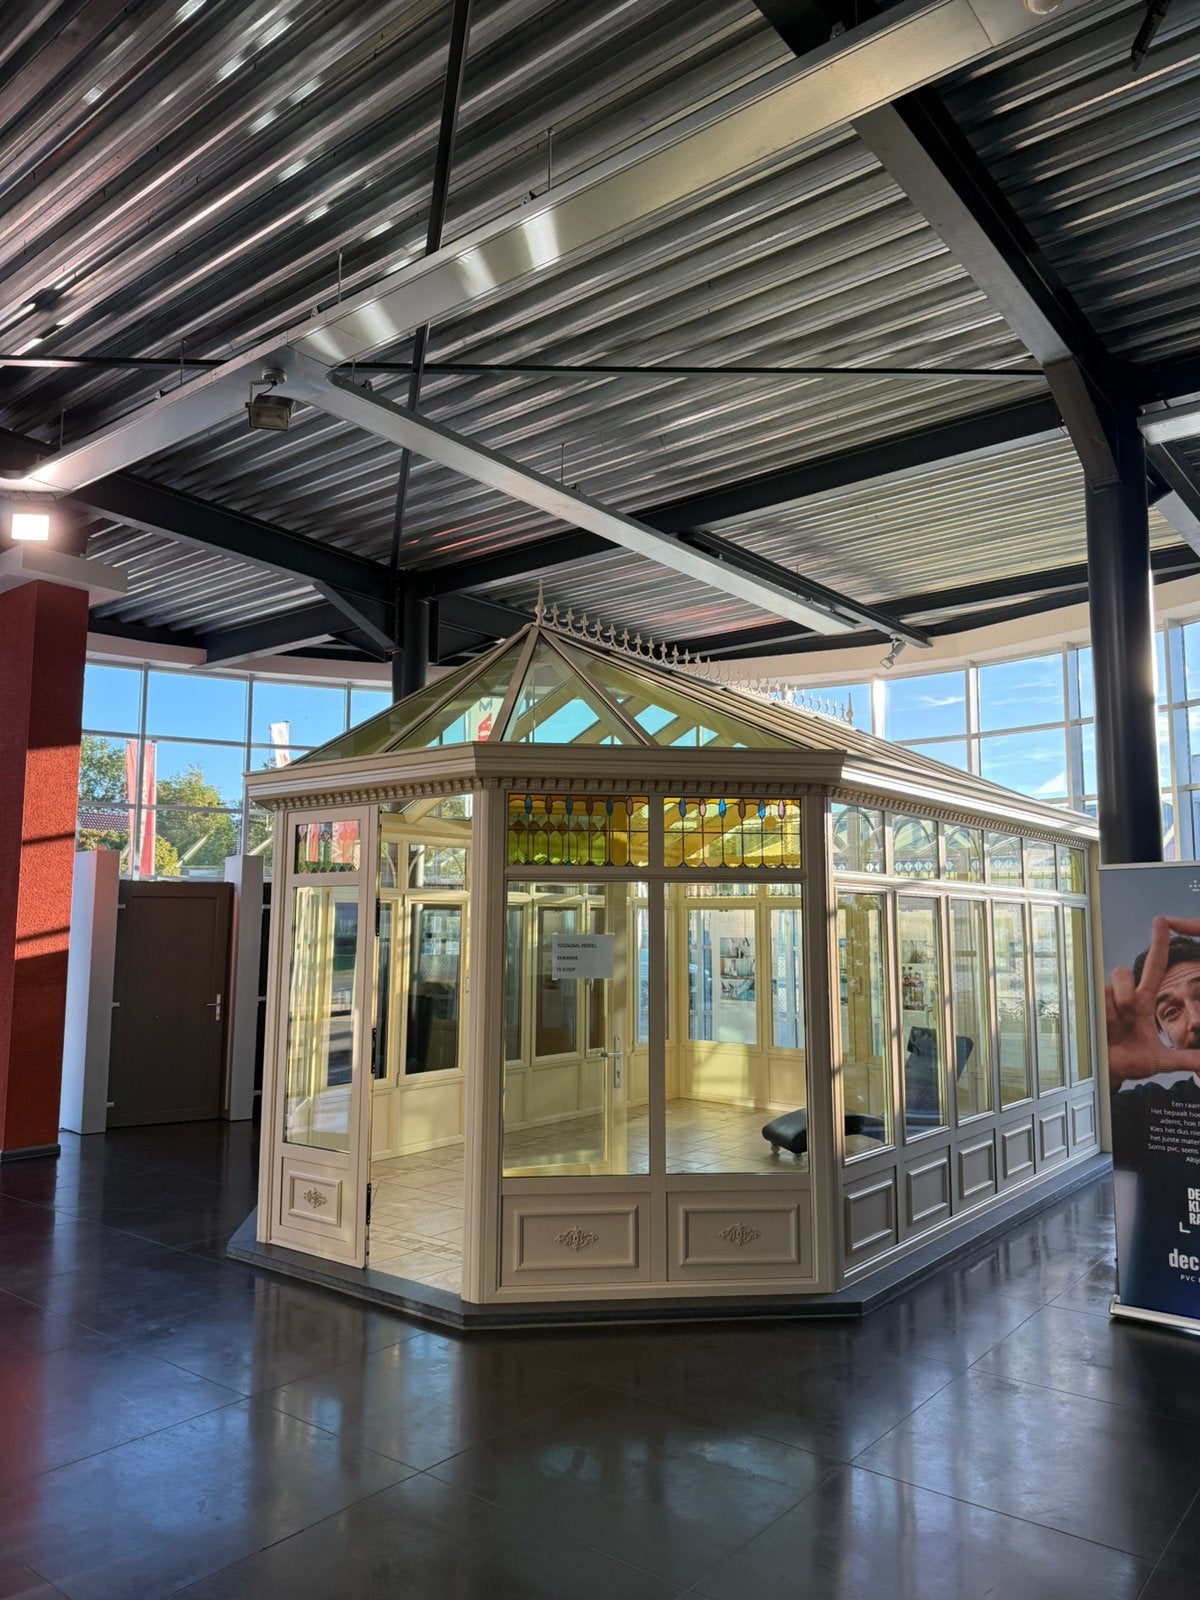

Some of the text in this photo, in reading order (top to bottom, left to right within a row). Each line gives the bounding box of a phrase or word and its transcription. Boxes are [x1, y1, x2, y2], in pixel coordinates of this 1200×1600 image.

[1171, 1100, 1184, 1108] Een
[1163, 1109, 1188, 1118] bepaalt
[1160, 1118, 1182, 1126] ademt,
[1184, 1119, 1197, 1127] hoe
[1162, 1136, 1180, 1144] juiste
[1147, 1143, 1199, 1154] Soms pvc, soms
[1168, 1248, 1200, 1271] dec
[1180, 1274, 1196, 1283] PVC
